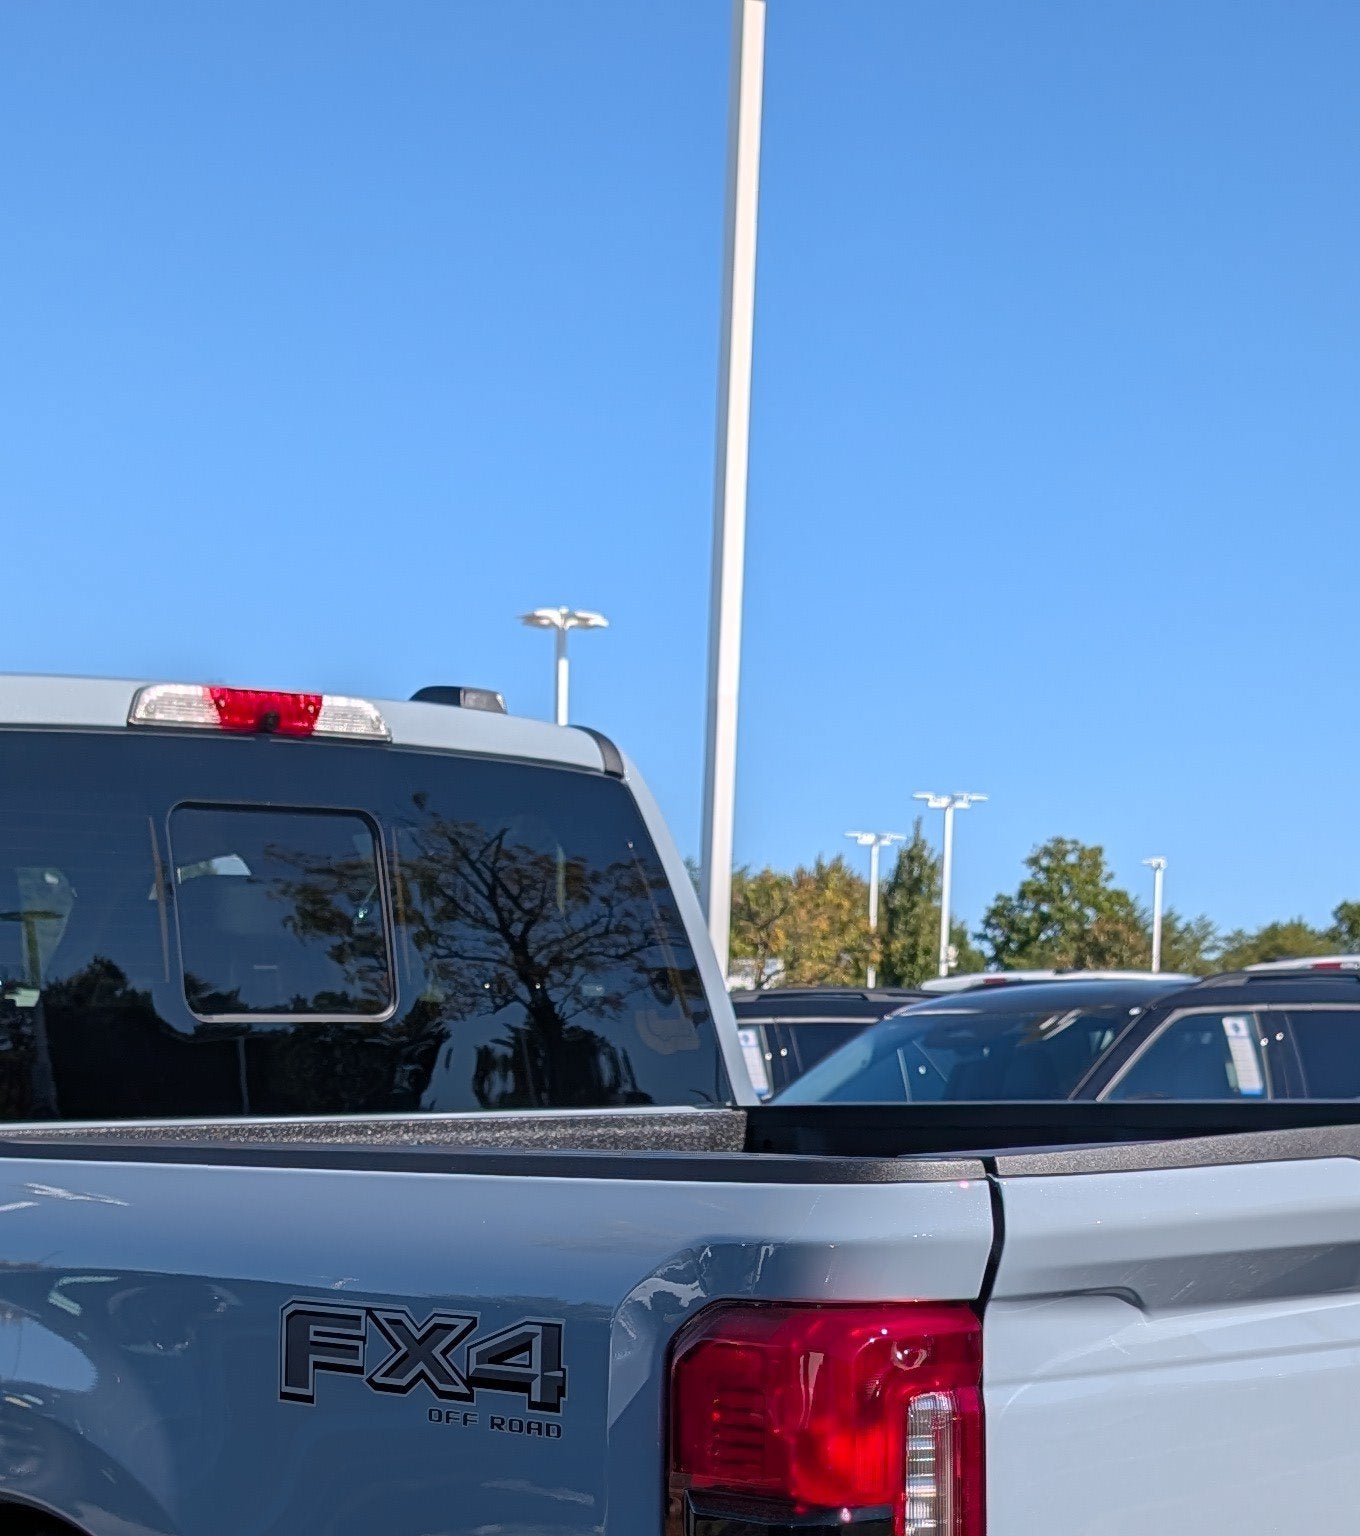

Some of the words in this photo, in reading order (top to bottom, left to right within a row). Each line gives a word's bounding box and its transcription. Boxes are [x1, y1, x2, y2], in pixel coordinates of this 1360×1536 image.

[278, 1296, 568, 1416] FX4
[427, 1407, 479, 1427] OFF
[490, 1415, 563, 1440] ROAD
